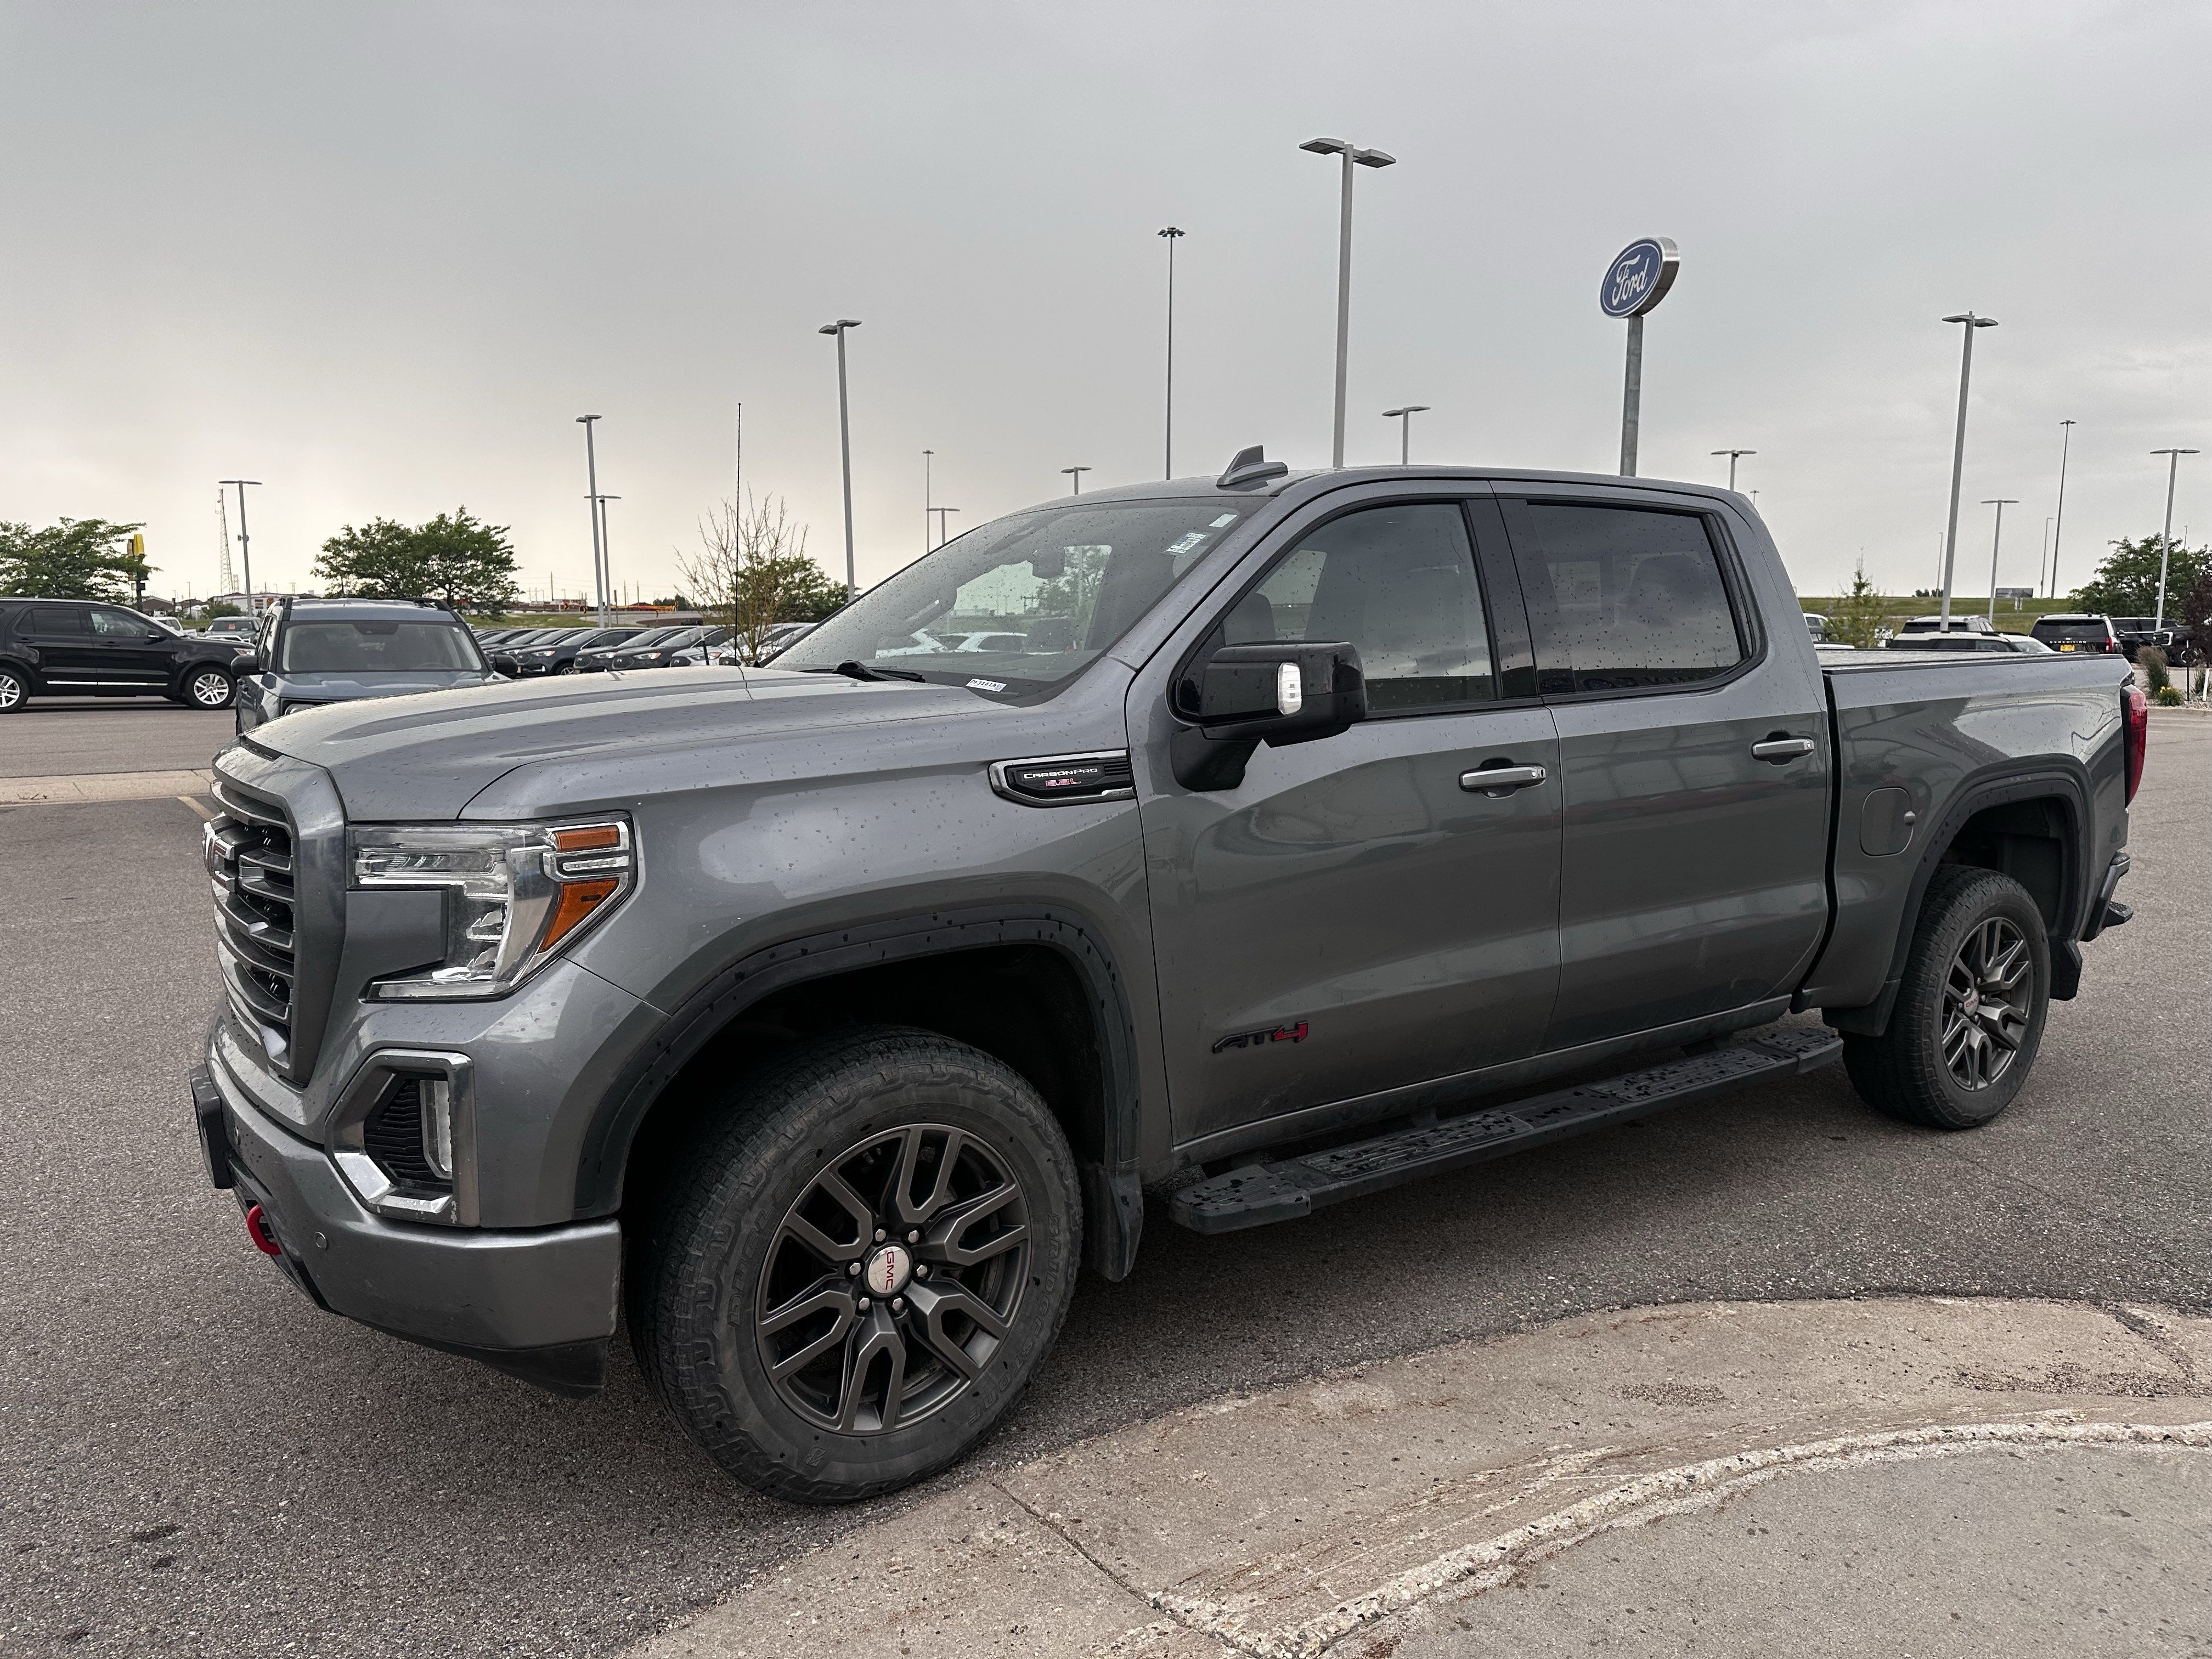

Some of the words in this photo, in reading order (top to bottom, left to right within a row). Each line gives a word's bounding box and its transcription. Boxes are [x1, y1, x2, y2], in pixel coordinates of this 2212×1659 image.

[1611, 254, 1650, 306] Ford
[1045, 778, 1081, 787] 6.2L
[1212, 1020, 1308, 1054] AT4
[885, 1251, 894, 1290] GMC
[967, 1212, 1062, 1427] BRIDGESTONE
